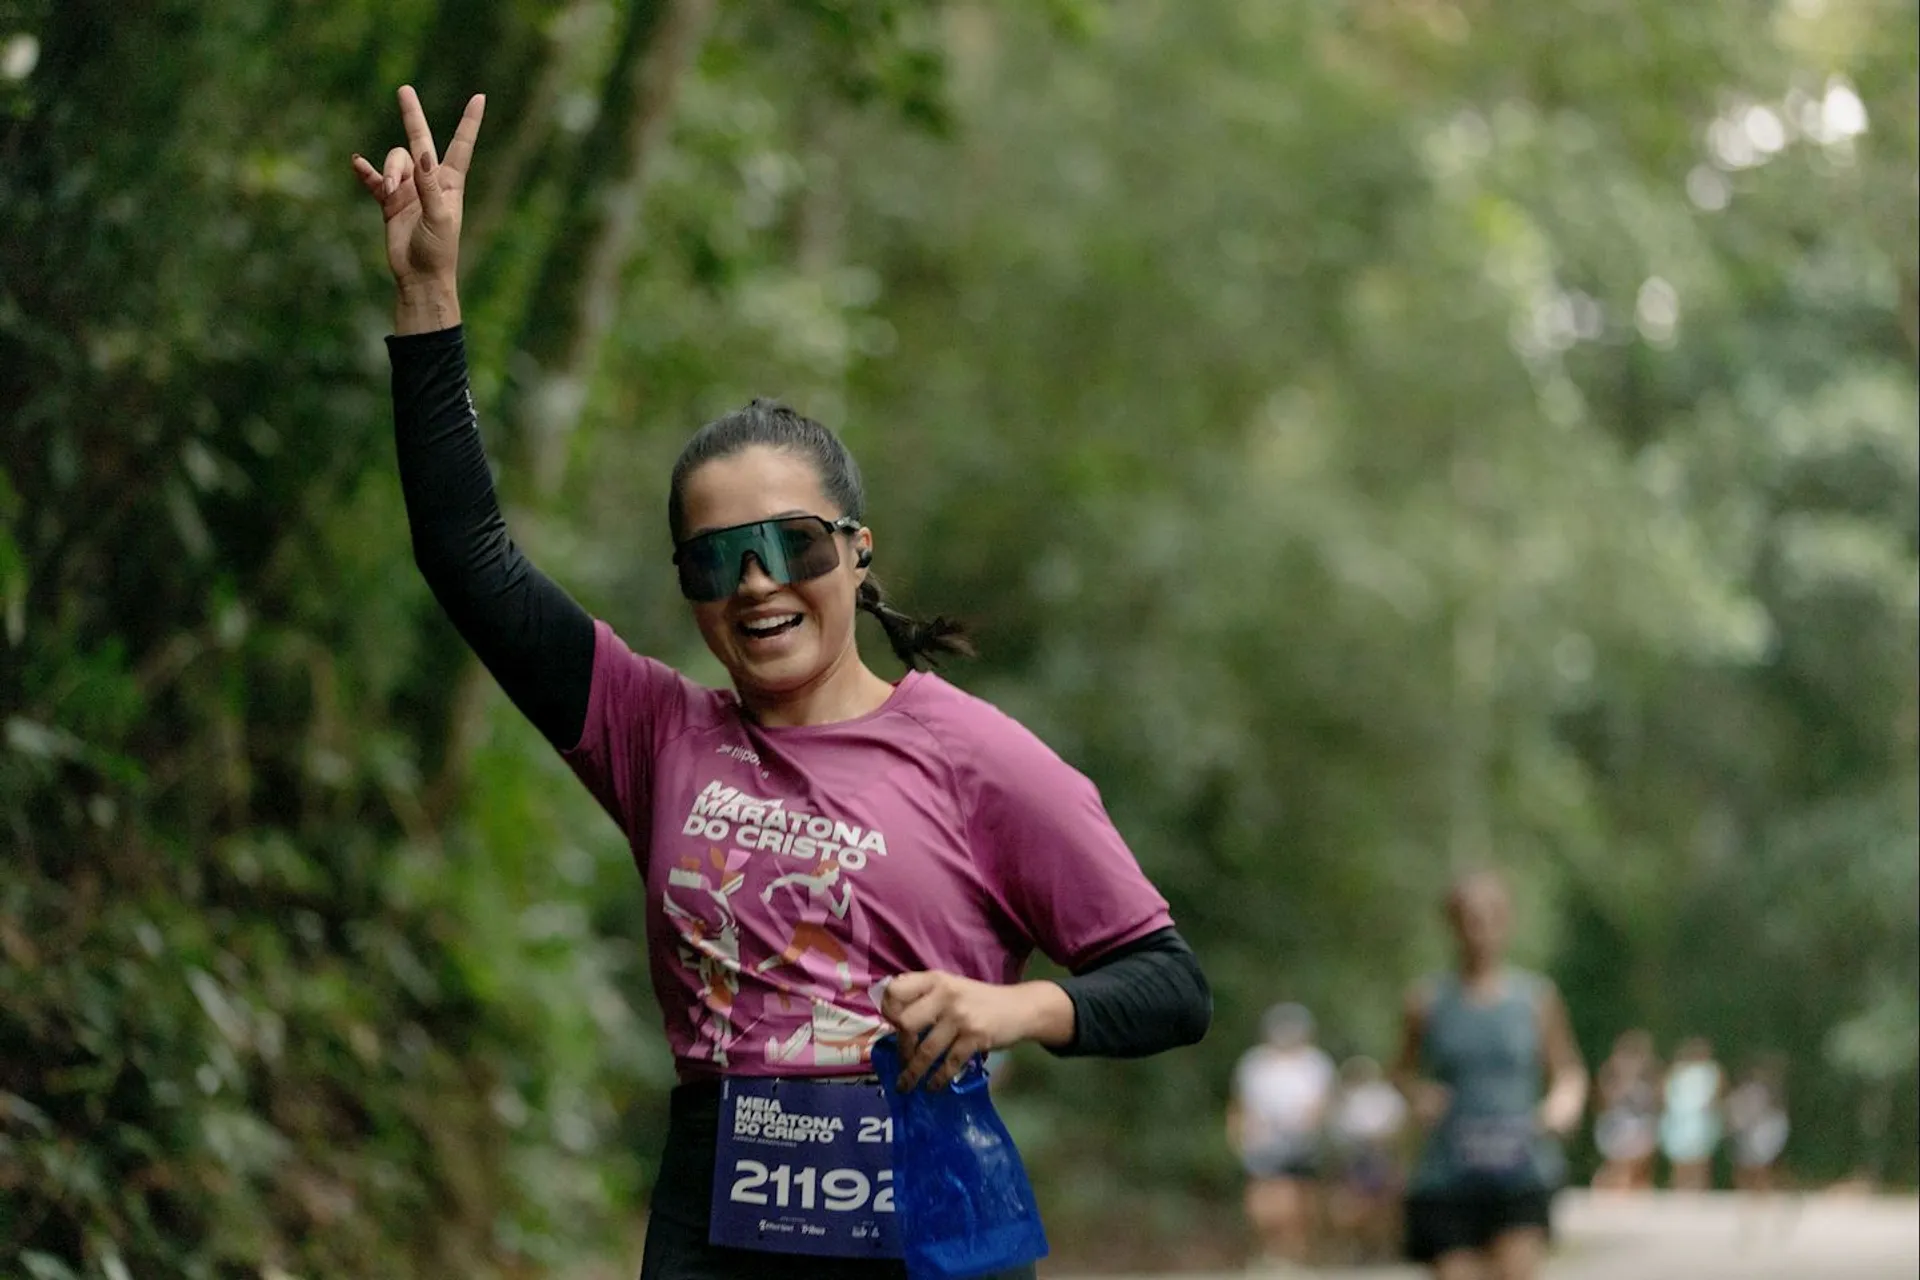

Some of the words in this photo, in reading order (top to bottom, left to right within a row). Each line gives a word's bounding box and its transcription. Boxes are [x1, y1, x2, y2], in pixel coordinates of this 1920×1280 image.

[682, 814, 730, 840] DO
[735, 826, 867, 870] CRISTO
[691, 795, 887, 856] MARATONA
[734, 1109, 844, 1132] MARATONA
[735, 1095, 782, 1113] MEIA
[733, 1122, 760, 1136] DO
[762, 1126, 835, 1144] CRISTO
[730, 1159, 896, 1212] 21192
